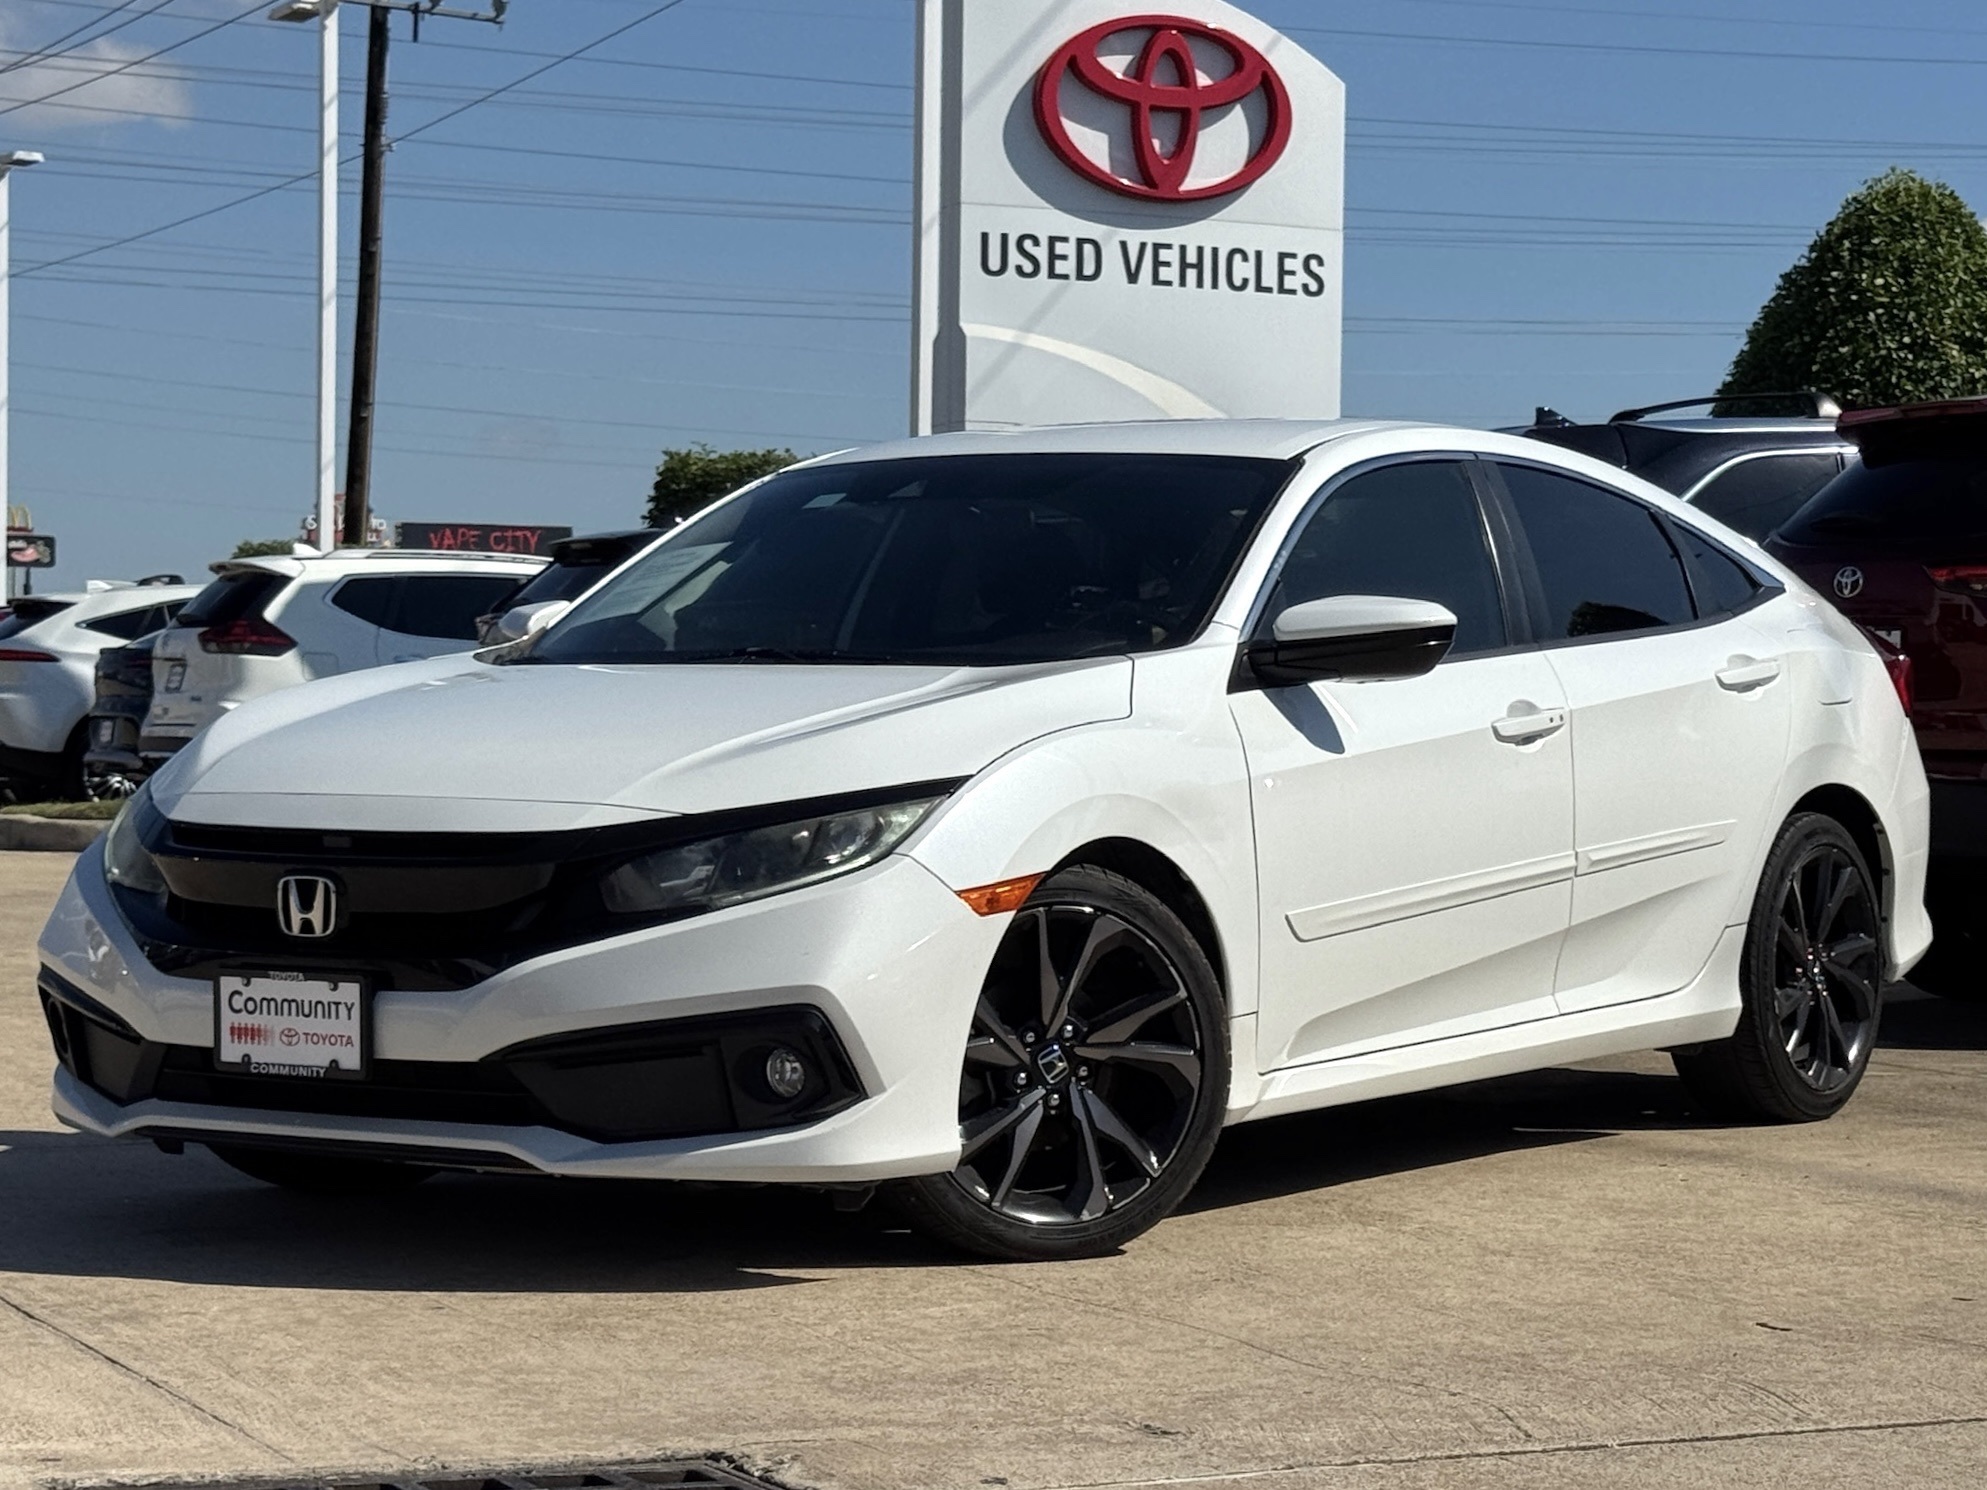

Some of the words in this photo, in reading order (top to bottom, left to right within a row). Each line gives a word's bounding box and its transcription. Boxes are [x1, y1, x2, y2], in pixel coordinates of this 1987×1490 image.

[980, 232, 1103, 282] USED
[1119, 240, 1325, 298] VEHICLES
[489, 529, 541, 553] CITY
[268, 970, 305, 982] TOYOTA
[302, 1032, 354, 1047] TOYOTA
[251, 1062, 326, 1077] COMMUNITY
